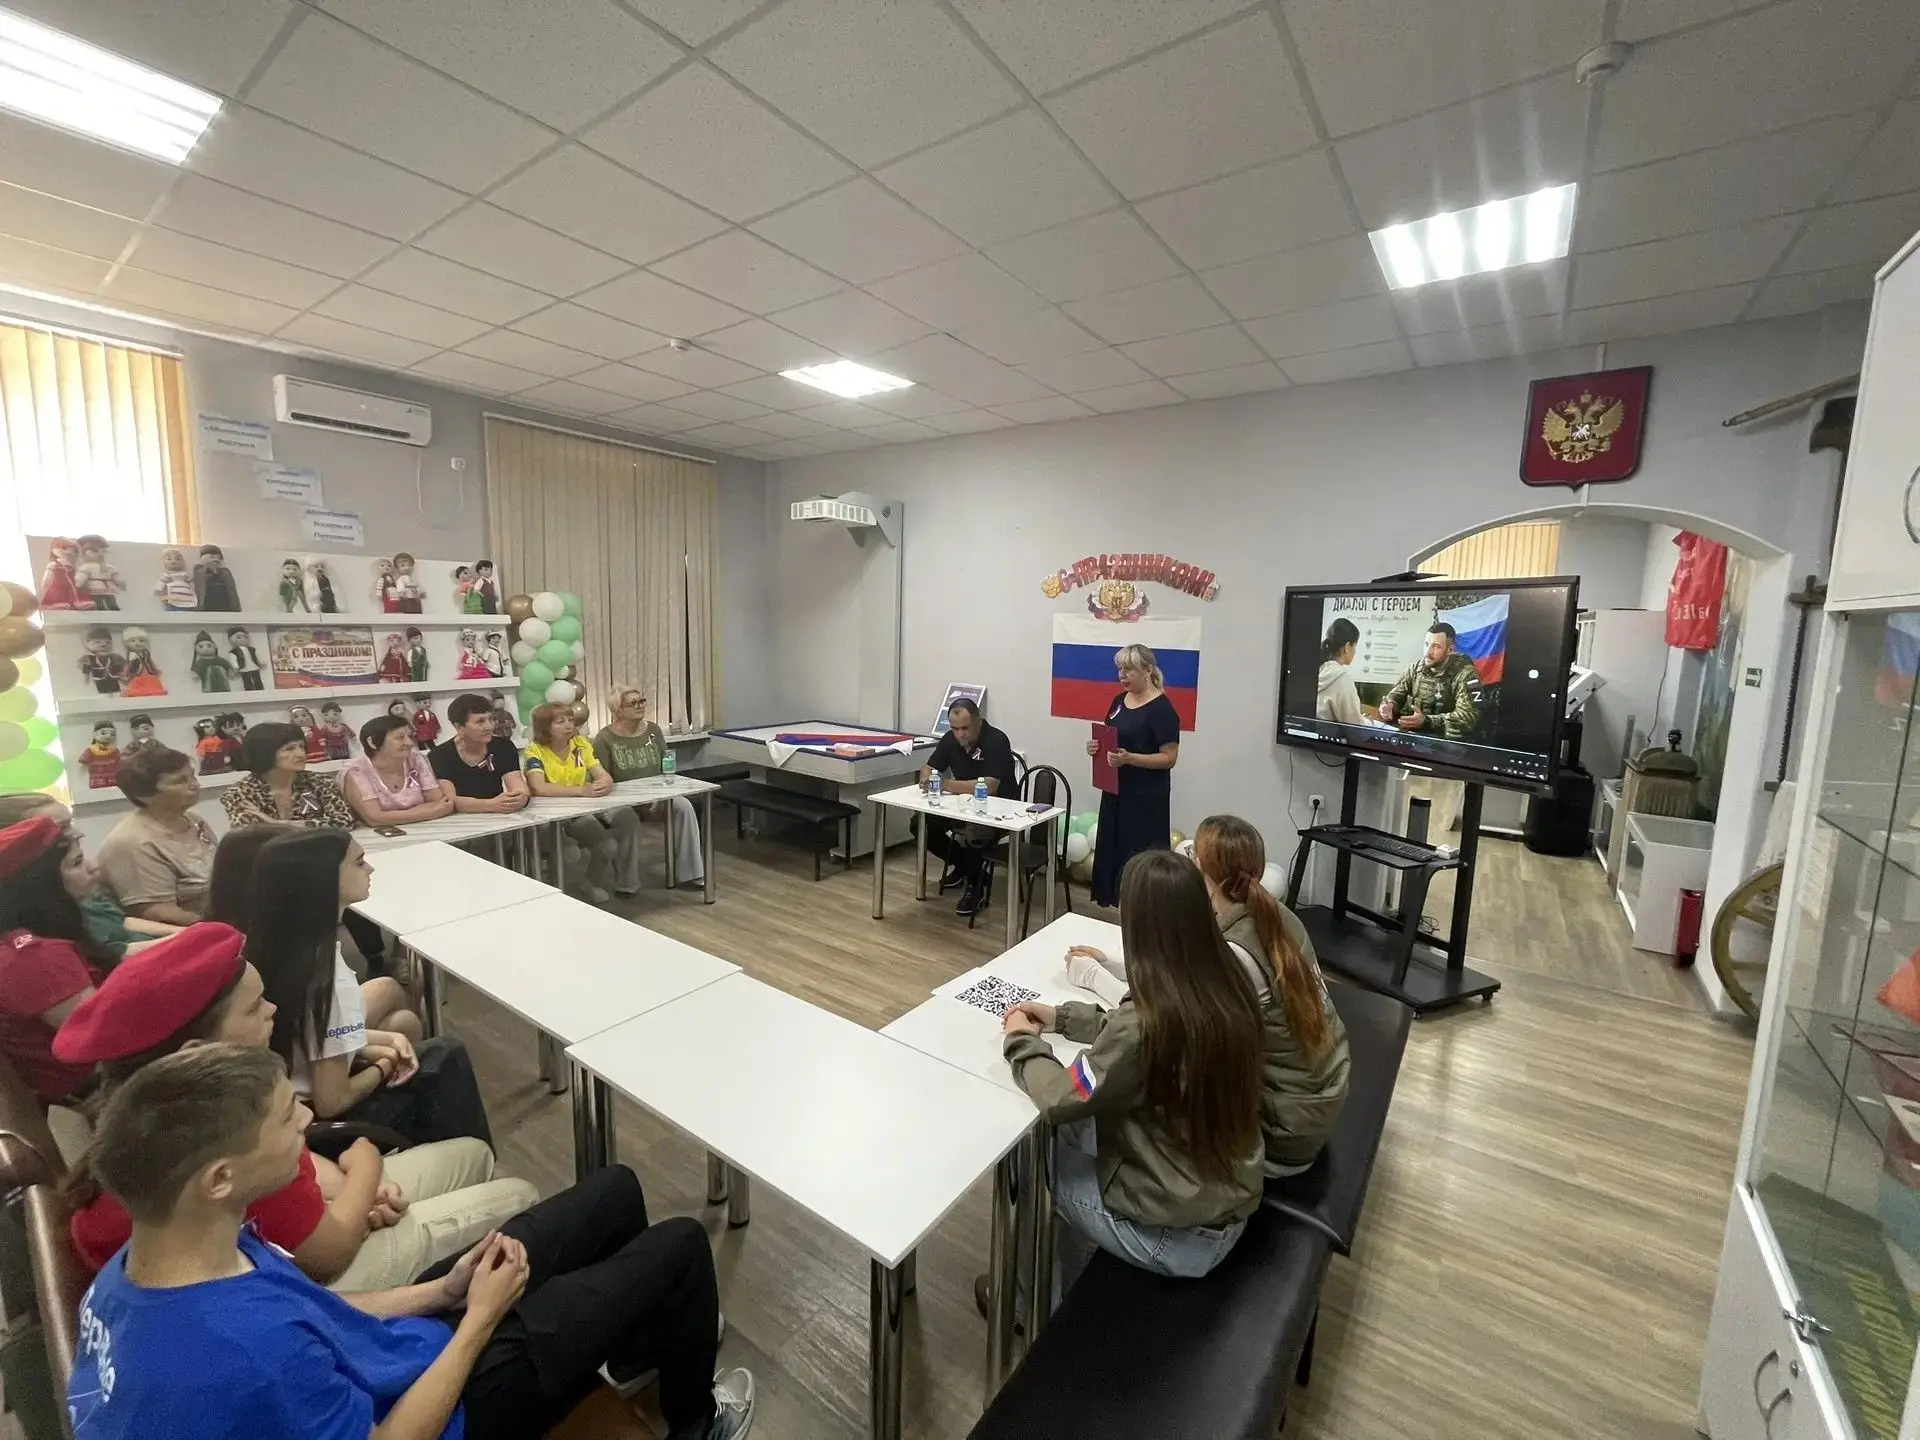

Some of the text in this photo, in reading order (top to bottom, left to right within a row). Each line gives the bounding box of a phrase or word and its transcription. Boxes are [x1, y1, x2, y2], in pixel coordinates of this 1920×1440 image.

[1333, 597, 1421, 612] ДИАЛОГ С ГЕРОЕМ
[292, 646, 373, 658] С ПРАЗДНИКОМ!
